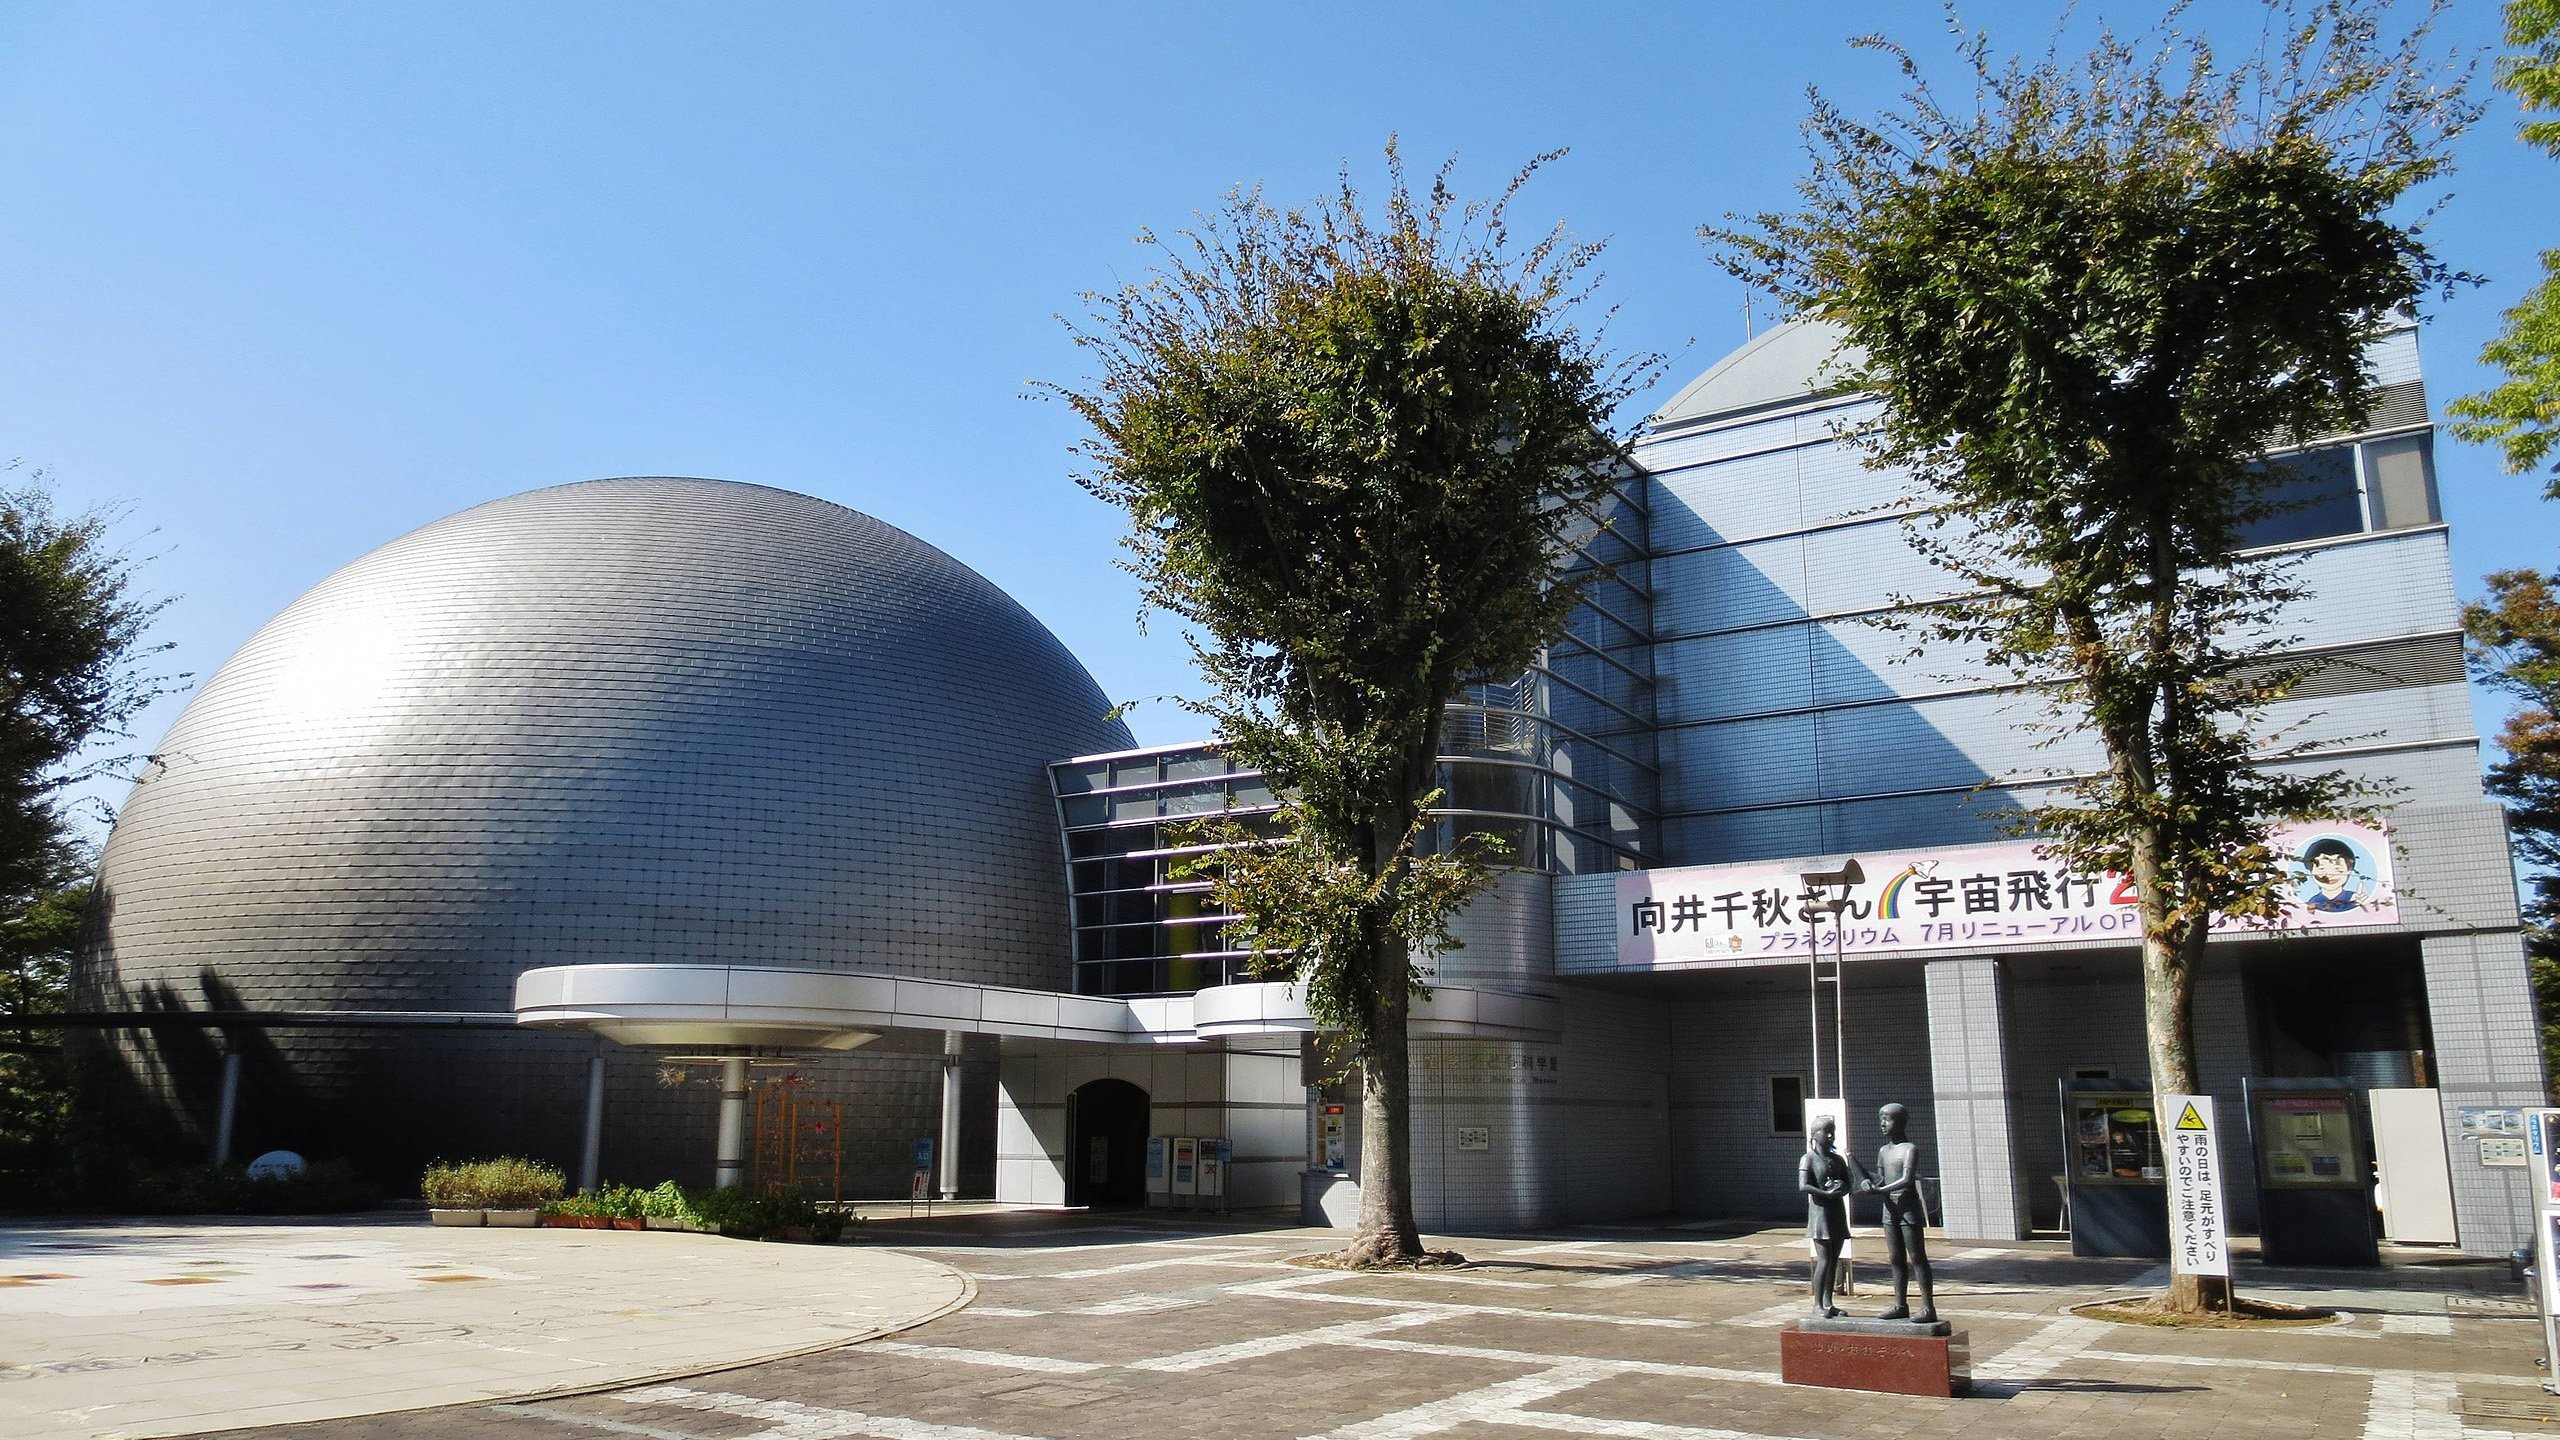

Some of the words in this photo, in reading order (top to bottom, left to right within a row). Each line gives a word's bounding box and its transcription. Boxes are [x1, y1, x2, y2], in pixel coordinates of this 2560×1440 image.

[1632, 884, 1872, 936] 向井千秋さん
[1760, 924, 1901, 950] プラネタリウム
[2177, 1134, 2199, 1266] やすいのでご注意ください
[2194, 1134, 2216, 1262] 雨の日は、足元がすべり
